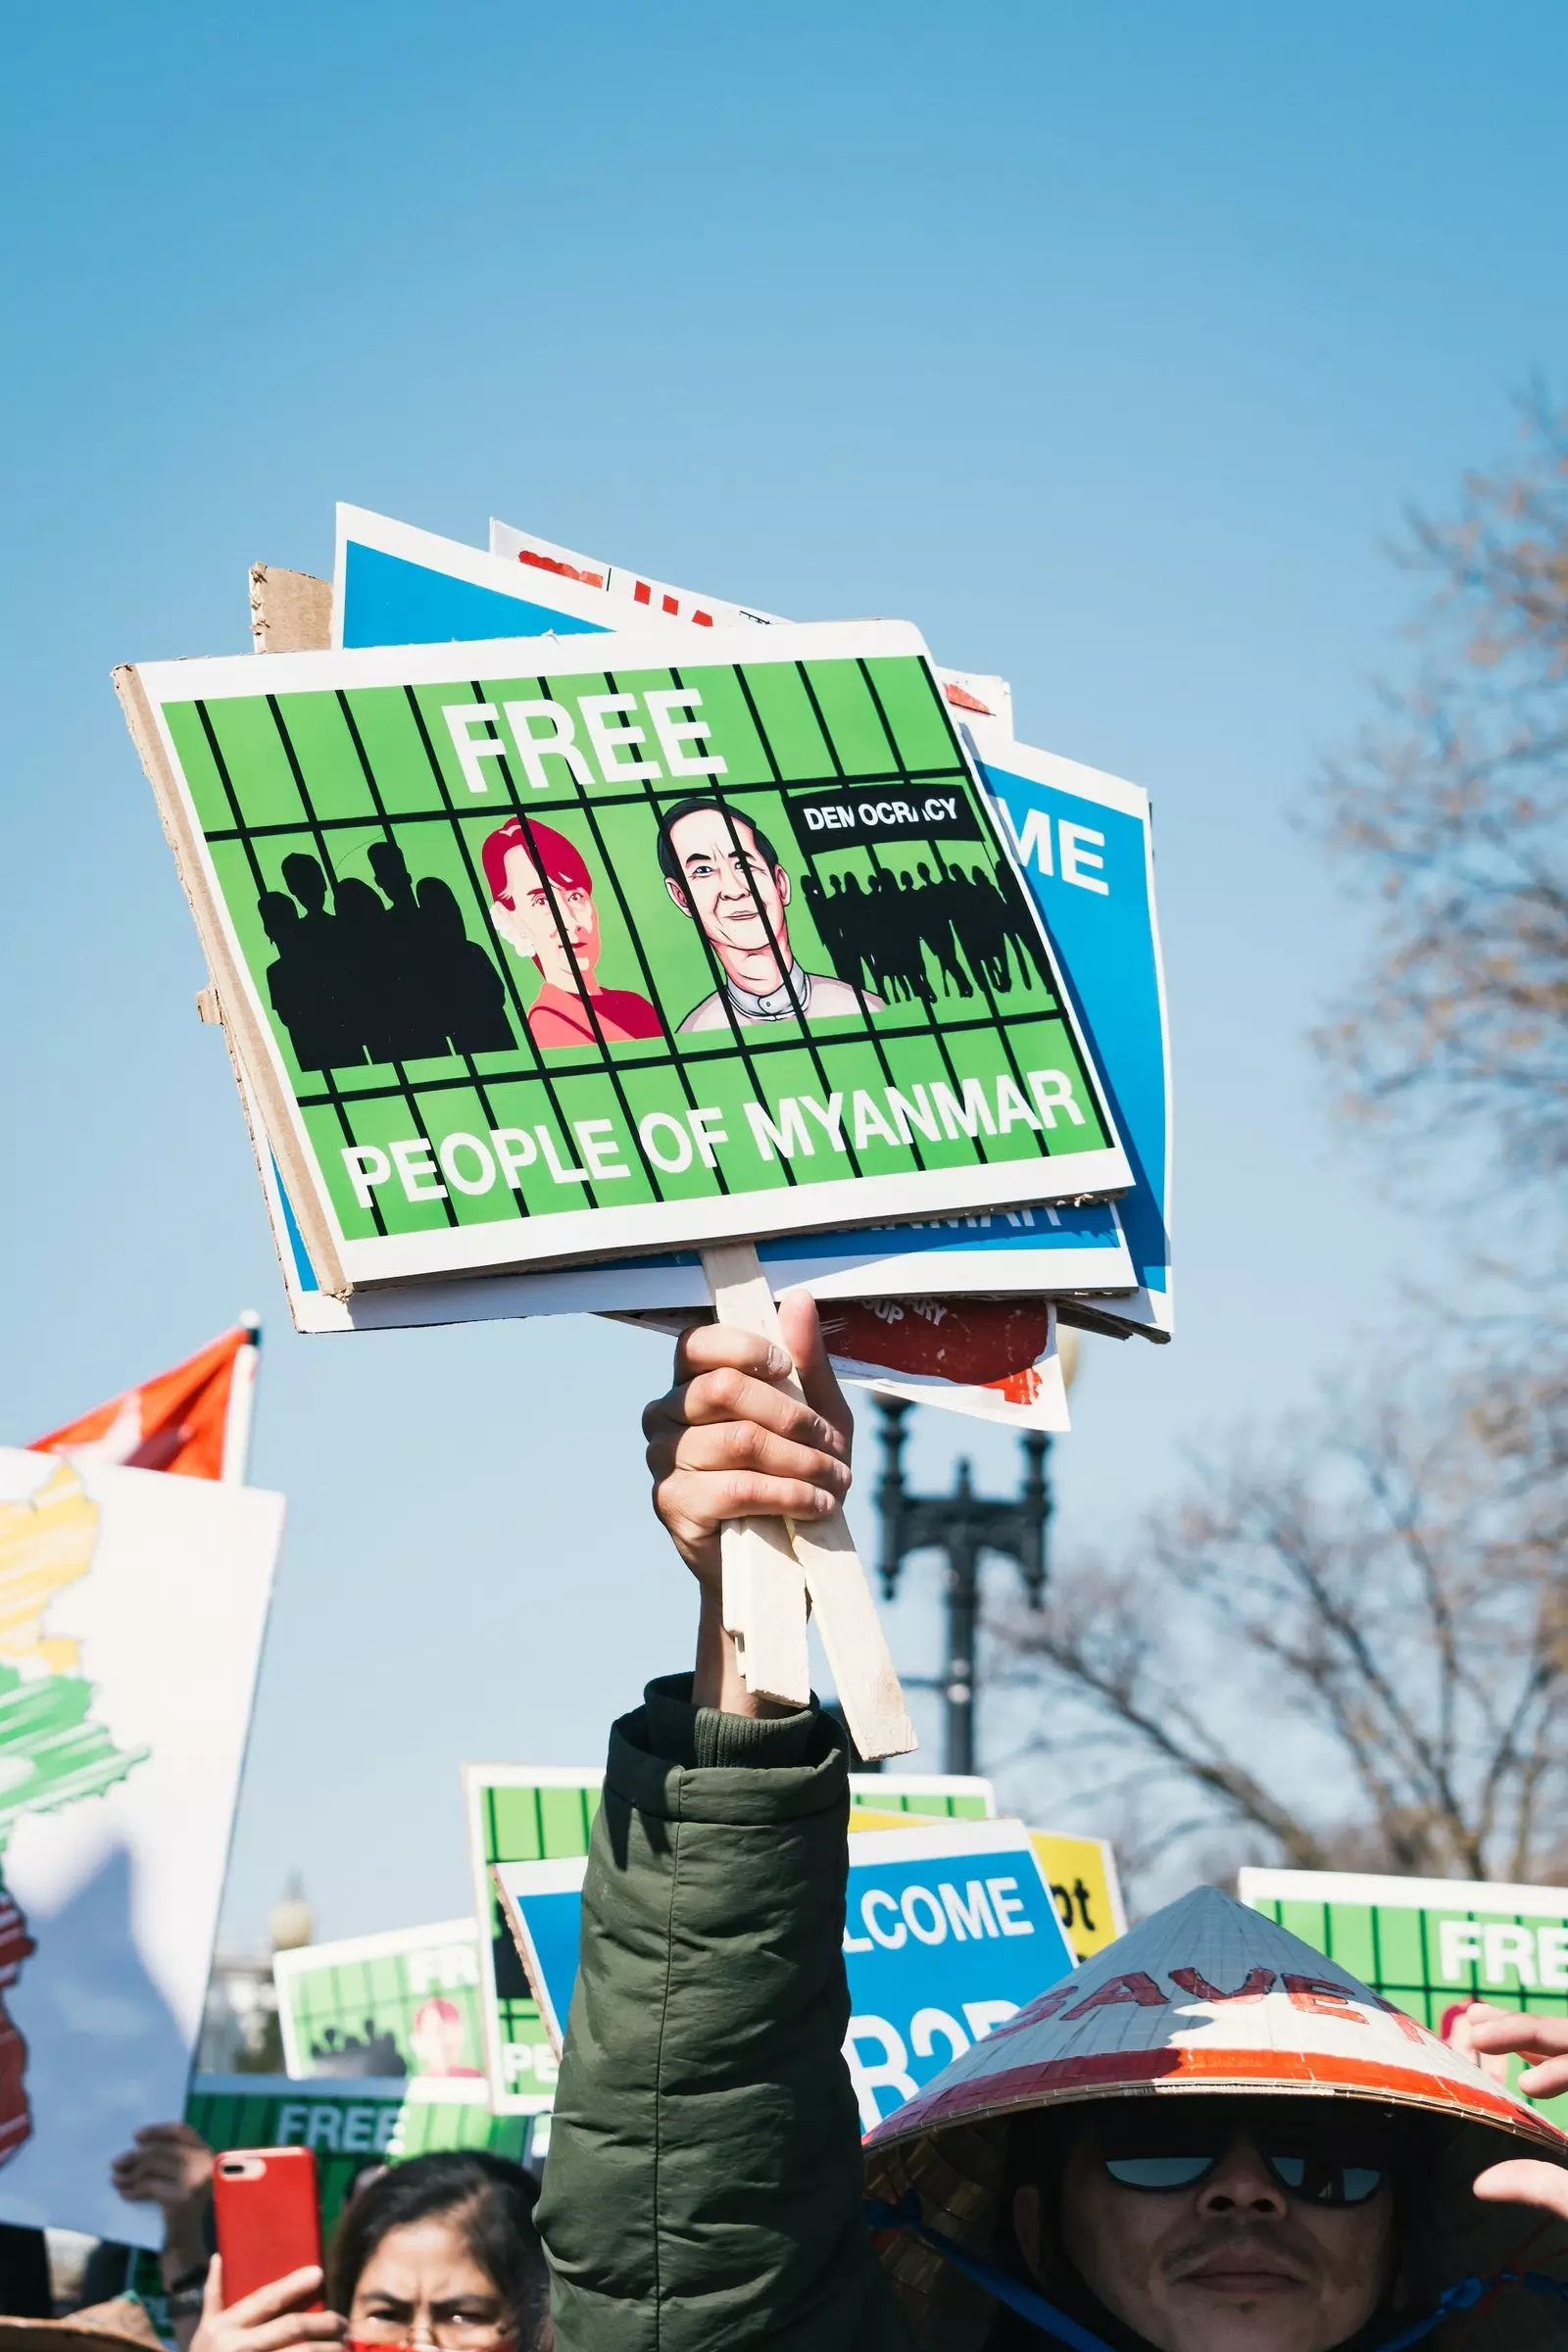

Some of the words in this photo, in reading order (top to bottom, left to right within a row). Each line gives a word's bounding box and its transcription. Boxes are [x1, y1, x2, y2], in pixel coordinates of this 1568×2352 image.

[441, 688, 729, 794] FREE
[340, 1118, 630, 1208] PEOPLE
[638, 1106, 729, 1174] OF
[743, 1069, 1086, 1161] MYANMAR
[1439, 1919, 1568, 1988] FRE
[275, 2104, 410, 2155] FREE
